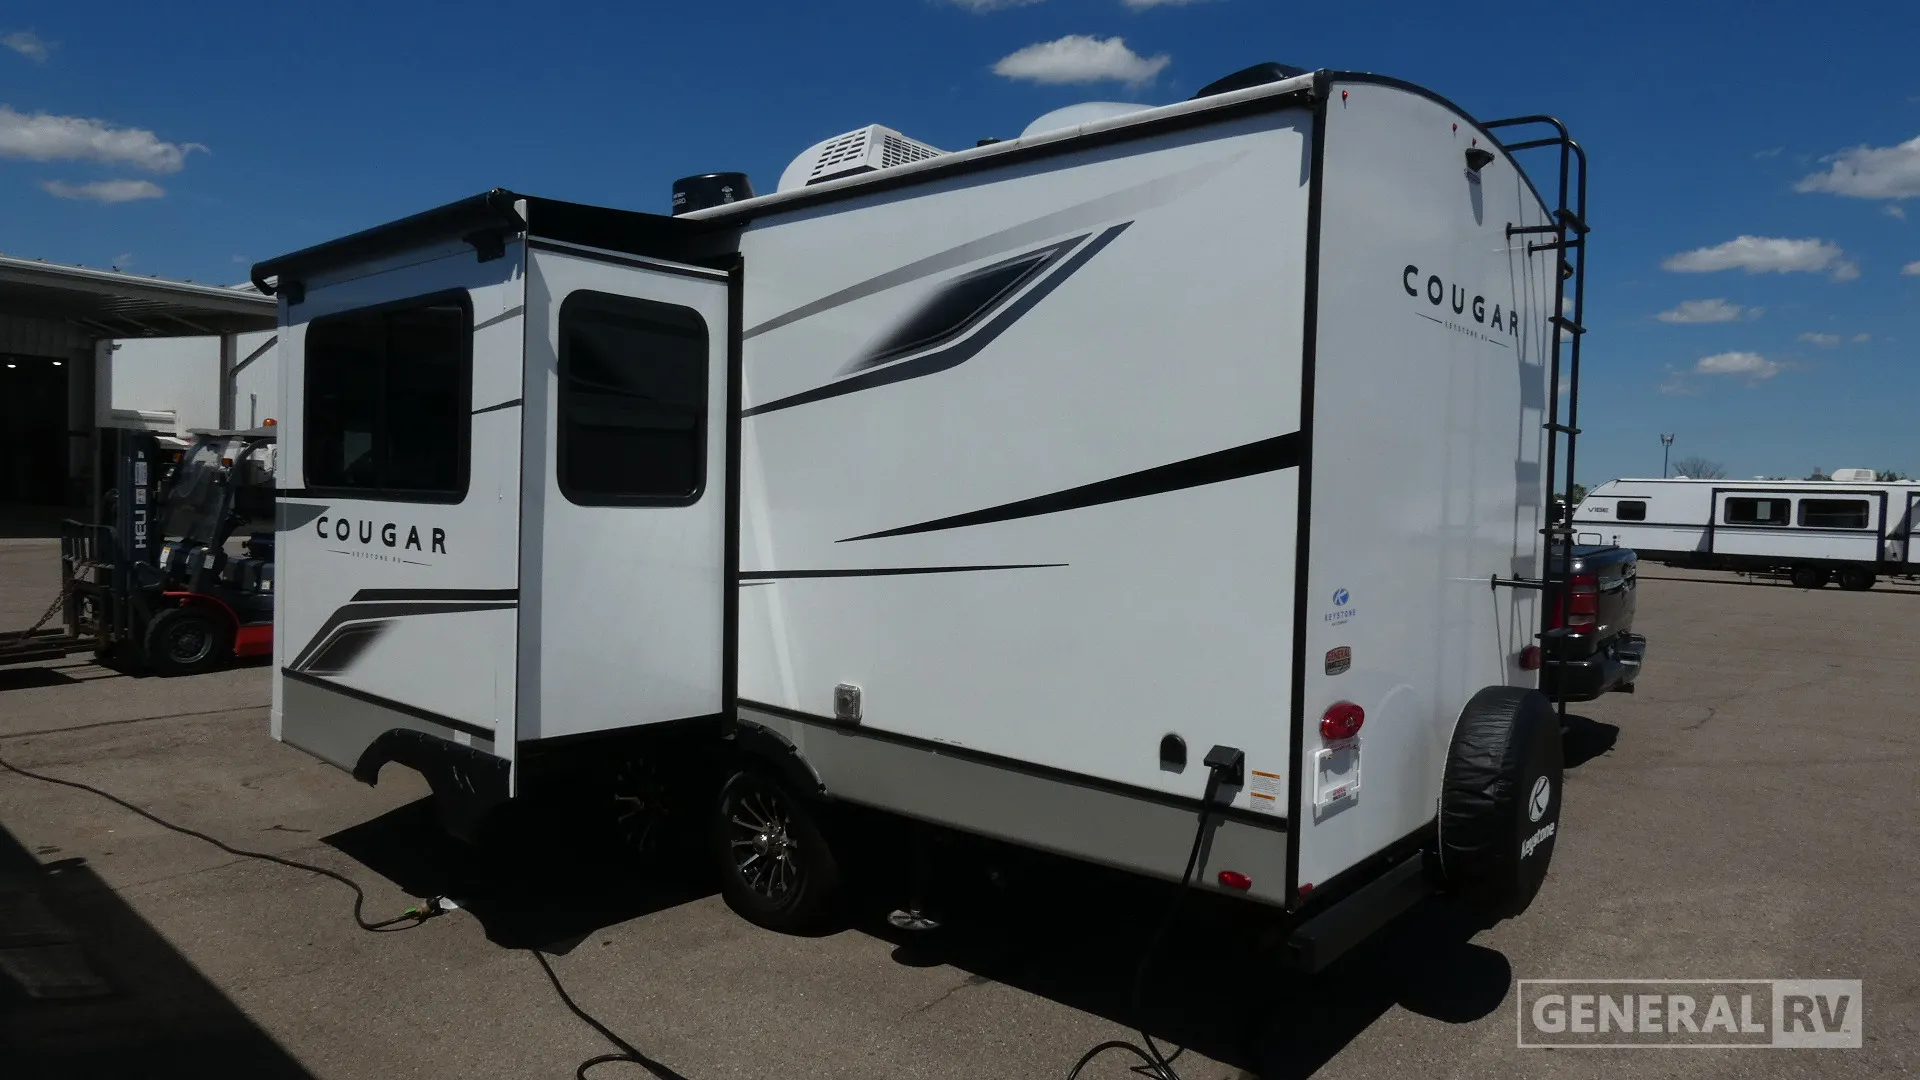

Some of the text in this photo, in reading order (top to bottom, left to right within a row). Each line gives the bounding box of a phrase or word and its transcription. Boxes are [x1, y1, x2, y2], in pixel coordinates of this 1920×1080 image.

[1403, 265, 1518, 338] COUGAR
[134, 509, 147, 549] HELI
[316, 516, 447, 555] COUGAR
[1324, 608, 1356, 621] KEYSTONE
